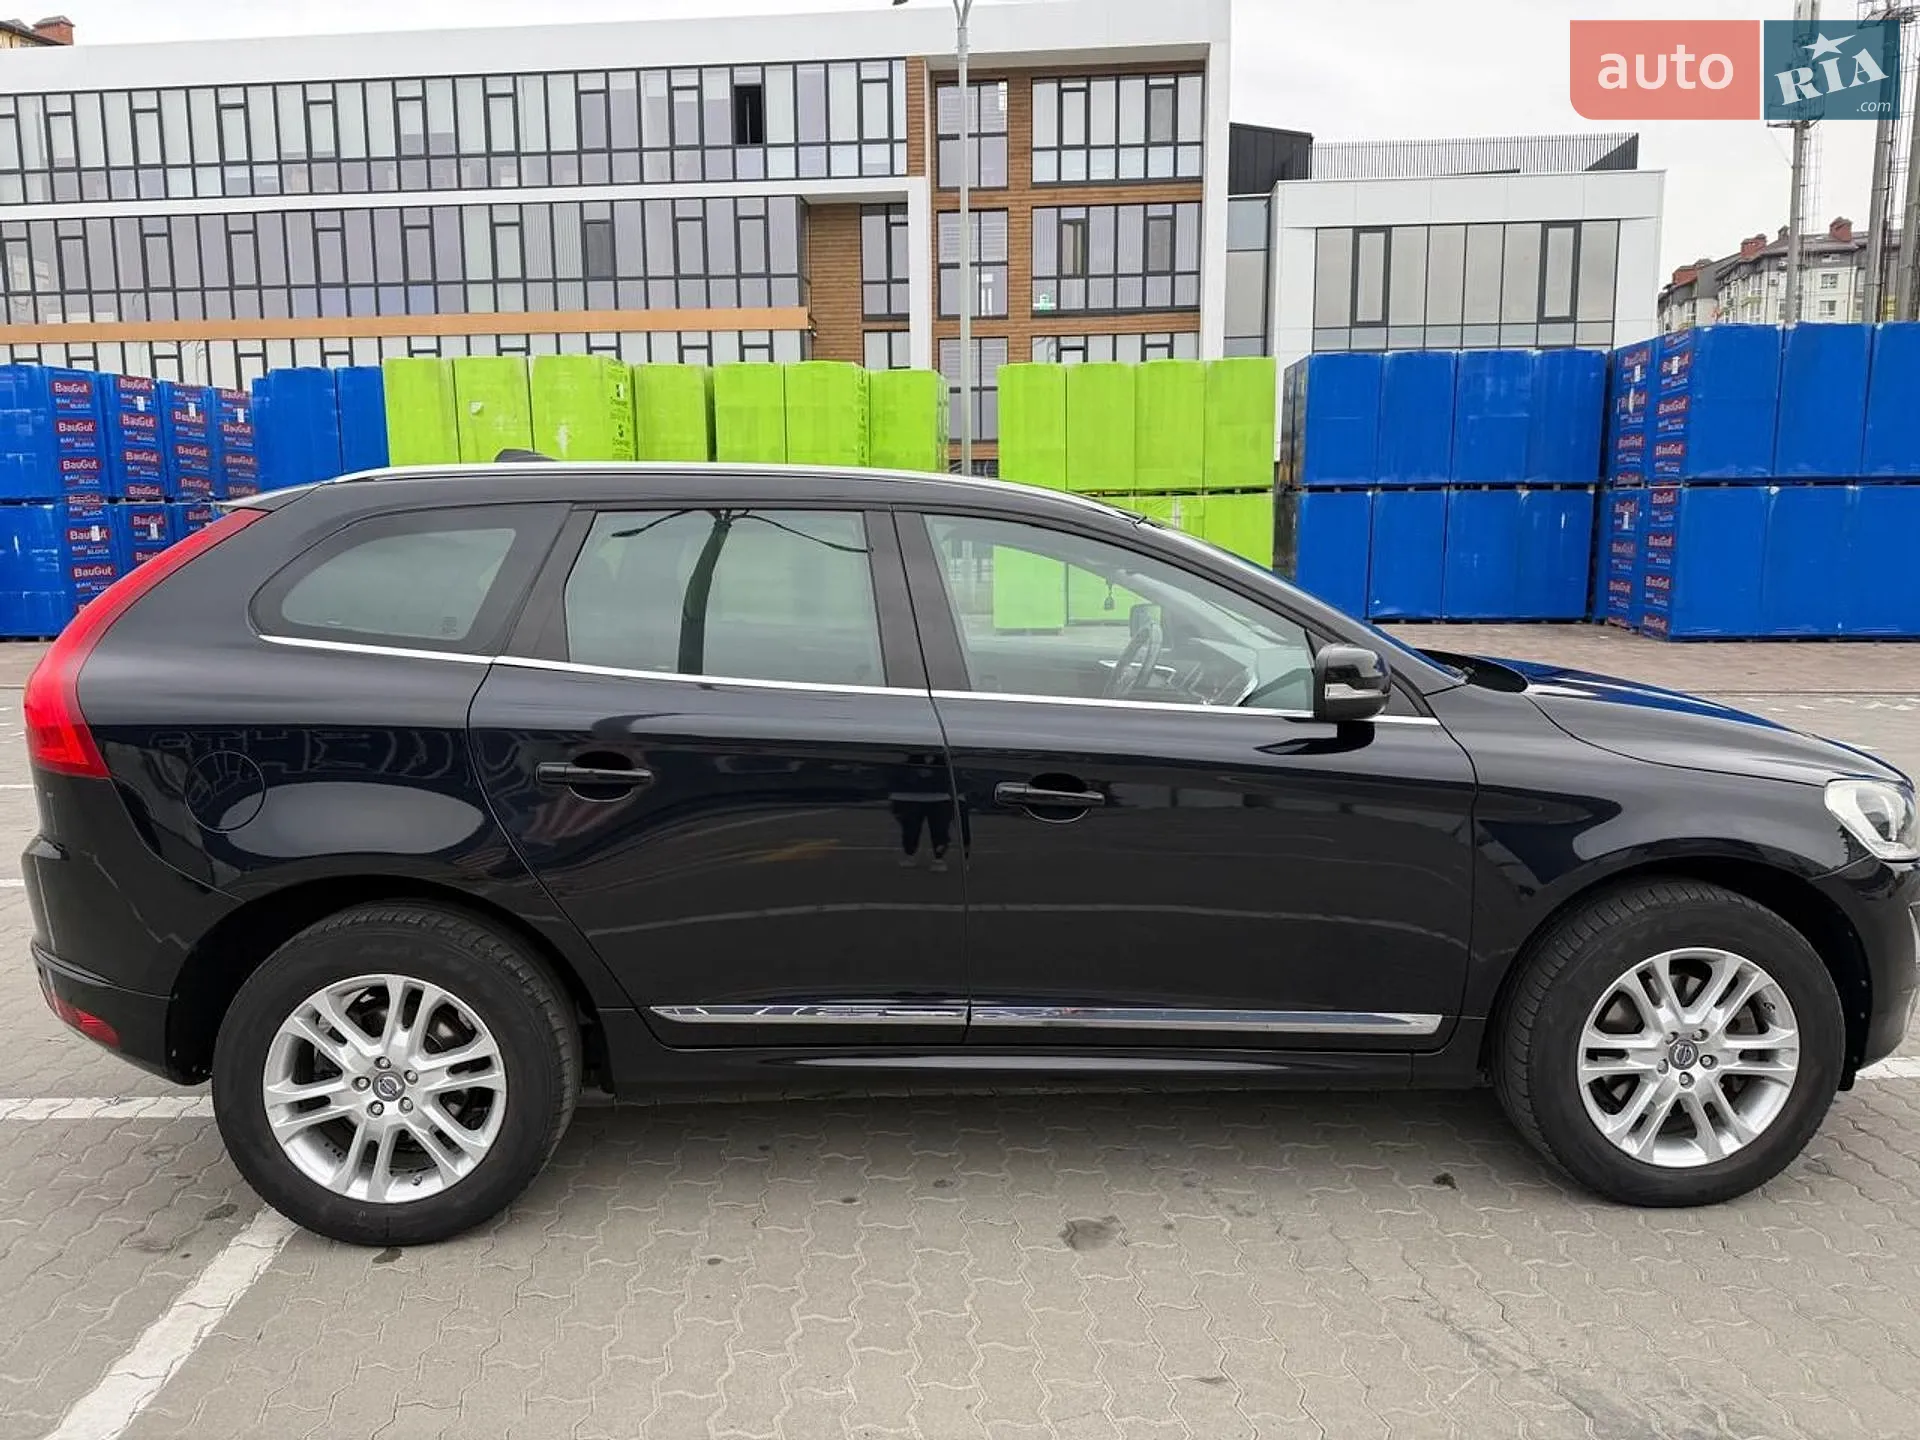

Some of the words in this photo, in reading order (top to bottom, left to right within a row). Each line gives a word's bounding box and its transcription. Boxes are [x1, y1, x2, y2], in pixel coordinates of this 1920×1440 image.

[54, 382, 88, 394] BauGut
[120, 378, 149, 390] BauGut
[1658, 399, 1686, 415] BauGut
[123, 415, 154, 427] BauGut
[58, 422, 94, 432] BauGut
[223, 424, 251, 434] BauGut
[178, 445, 207, 457] BauGut
[1656, 445, 1682, 456] BauGut
[126, 451, 157, 462] BauGut
[226, 455, 253, 465] BauGut
[63, 459, 97, 470] BauGut
[181, 478, 210, 489] BauGut
[128, 486, 160, 495] BauGut
[70, 528, 107, 540] Bauut
[1648, 535, 1672, 546] BauGut
[74, 566, 112, 577] BauGut
[1645, 575, 1670, 589] BauGut
